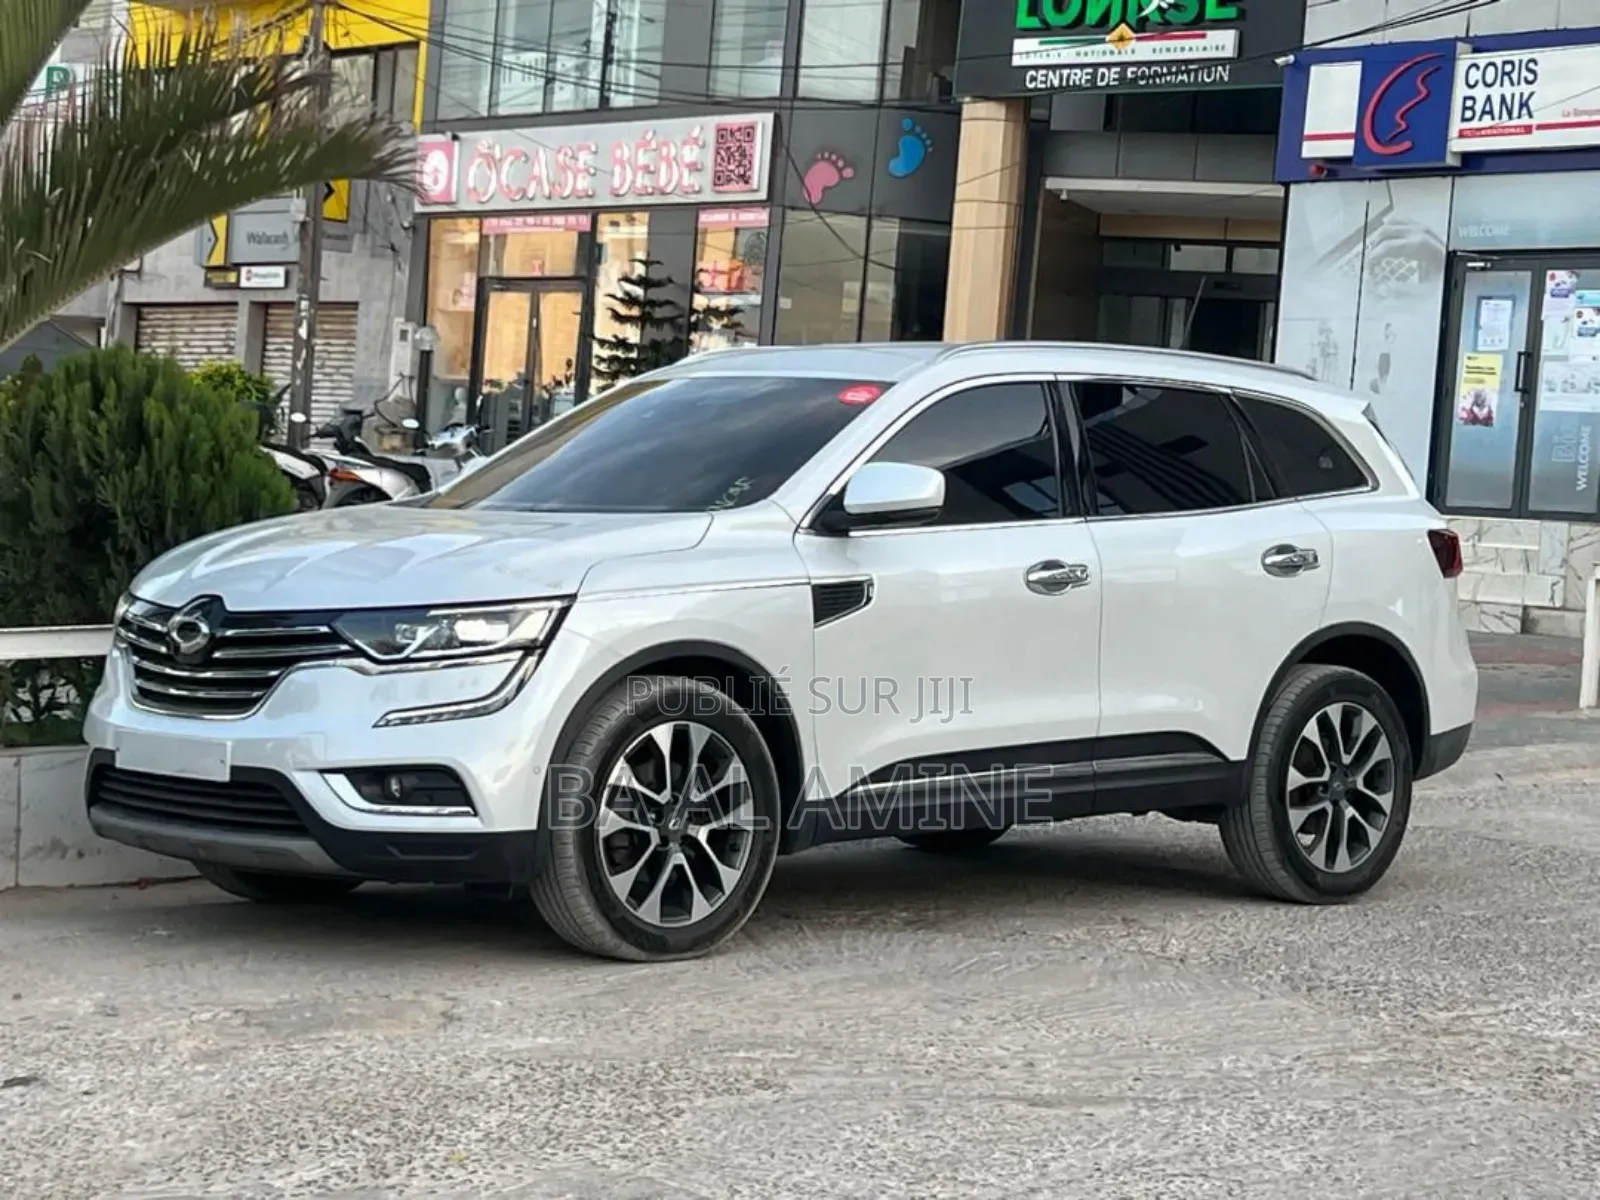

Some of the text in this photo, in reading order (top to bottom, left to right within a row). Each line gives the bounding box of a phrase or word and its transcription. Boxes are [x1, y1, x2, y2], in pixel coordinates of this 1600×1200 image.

[1025, 64, 1230, 89] CENTRE DE FORMATION
[1464, 57, 1539, 90] CORIS
[1459, 91, 1536, 123] BANK
[610, 124, 706, 197] BÉBÉ
[1576, 425, 1592, 491] WELCOME
